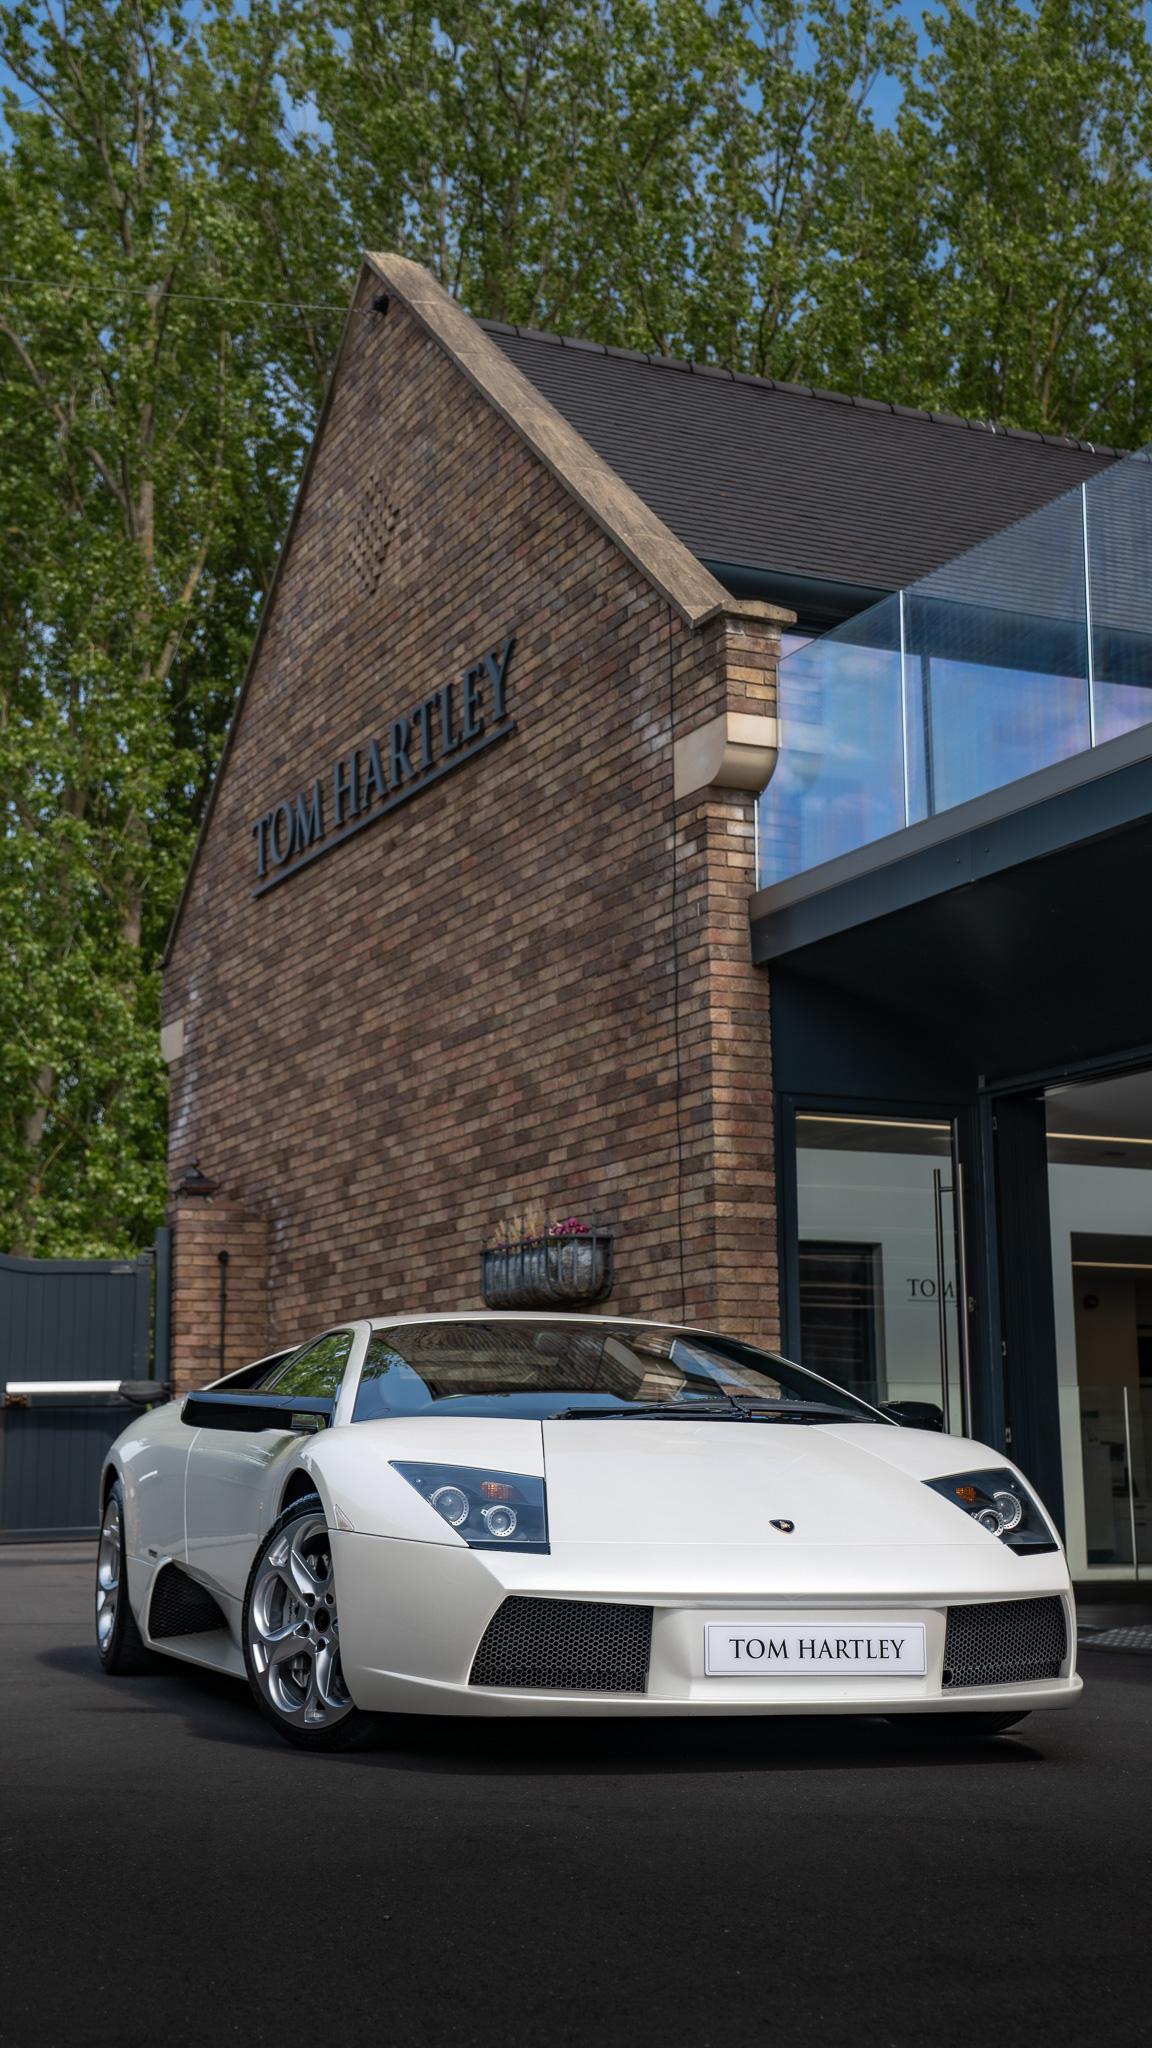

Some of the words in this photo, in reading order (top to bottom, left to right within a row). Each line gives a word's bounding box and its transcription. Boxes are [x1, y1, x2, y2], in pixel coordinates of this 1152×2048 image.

[252, 778, 325, 879] TOM
[333, 638, 518, 828] HARTLEY
[729, 1638, 790, 1659] TOM
[798, 1639, 905, 1659] HARTLEY
